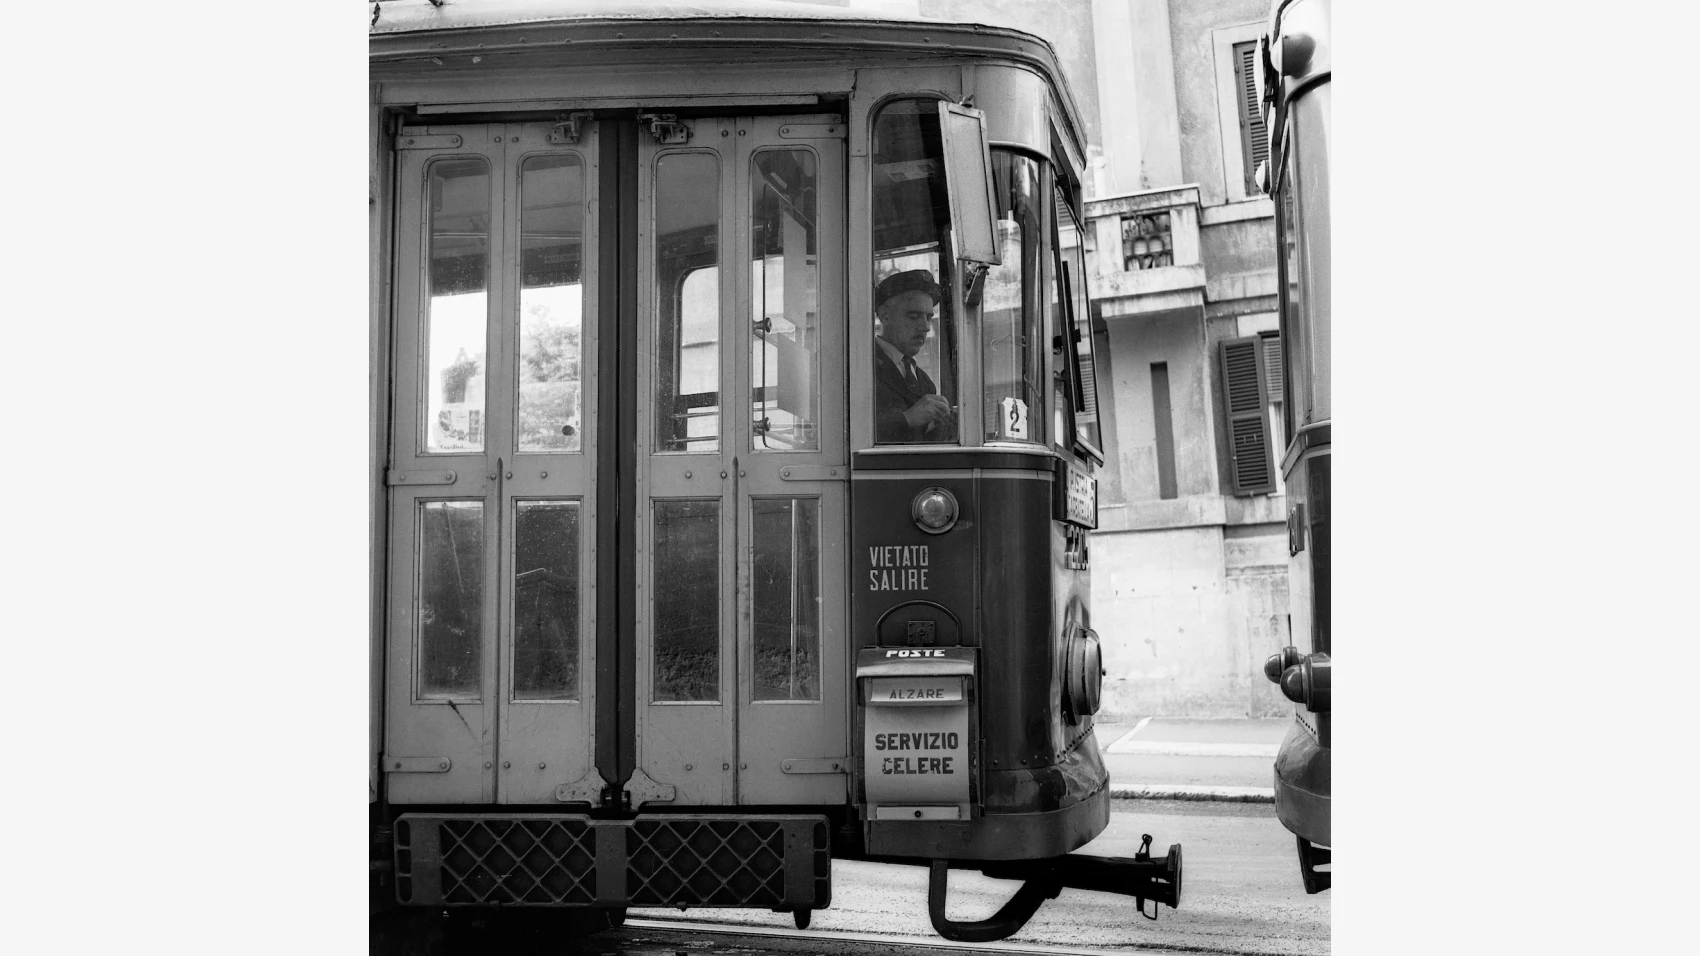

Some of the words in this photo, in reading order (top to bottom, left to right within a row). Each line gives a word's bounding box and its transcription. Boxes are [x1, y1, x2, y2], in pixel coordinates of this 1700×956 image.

[1010, 407, 1020, 432] 2
[869, 546, 929, 567] VIETATO
[869, 569, 929, 591] SALIRE
[886, 650, 946, 658] POSTE
[889, 690, 945, 700] ALZARE
[875, 733, 959, 751] SERVIZIO
[882, 758, 954, 775] CELERE
